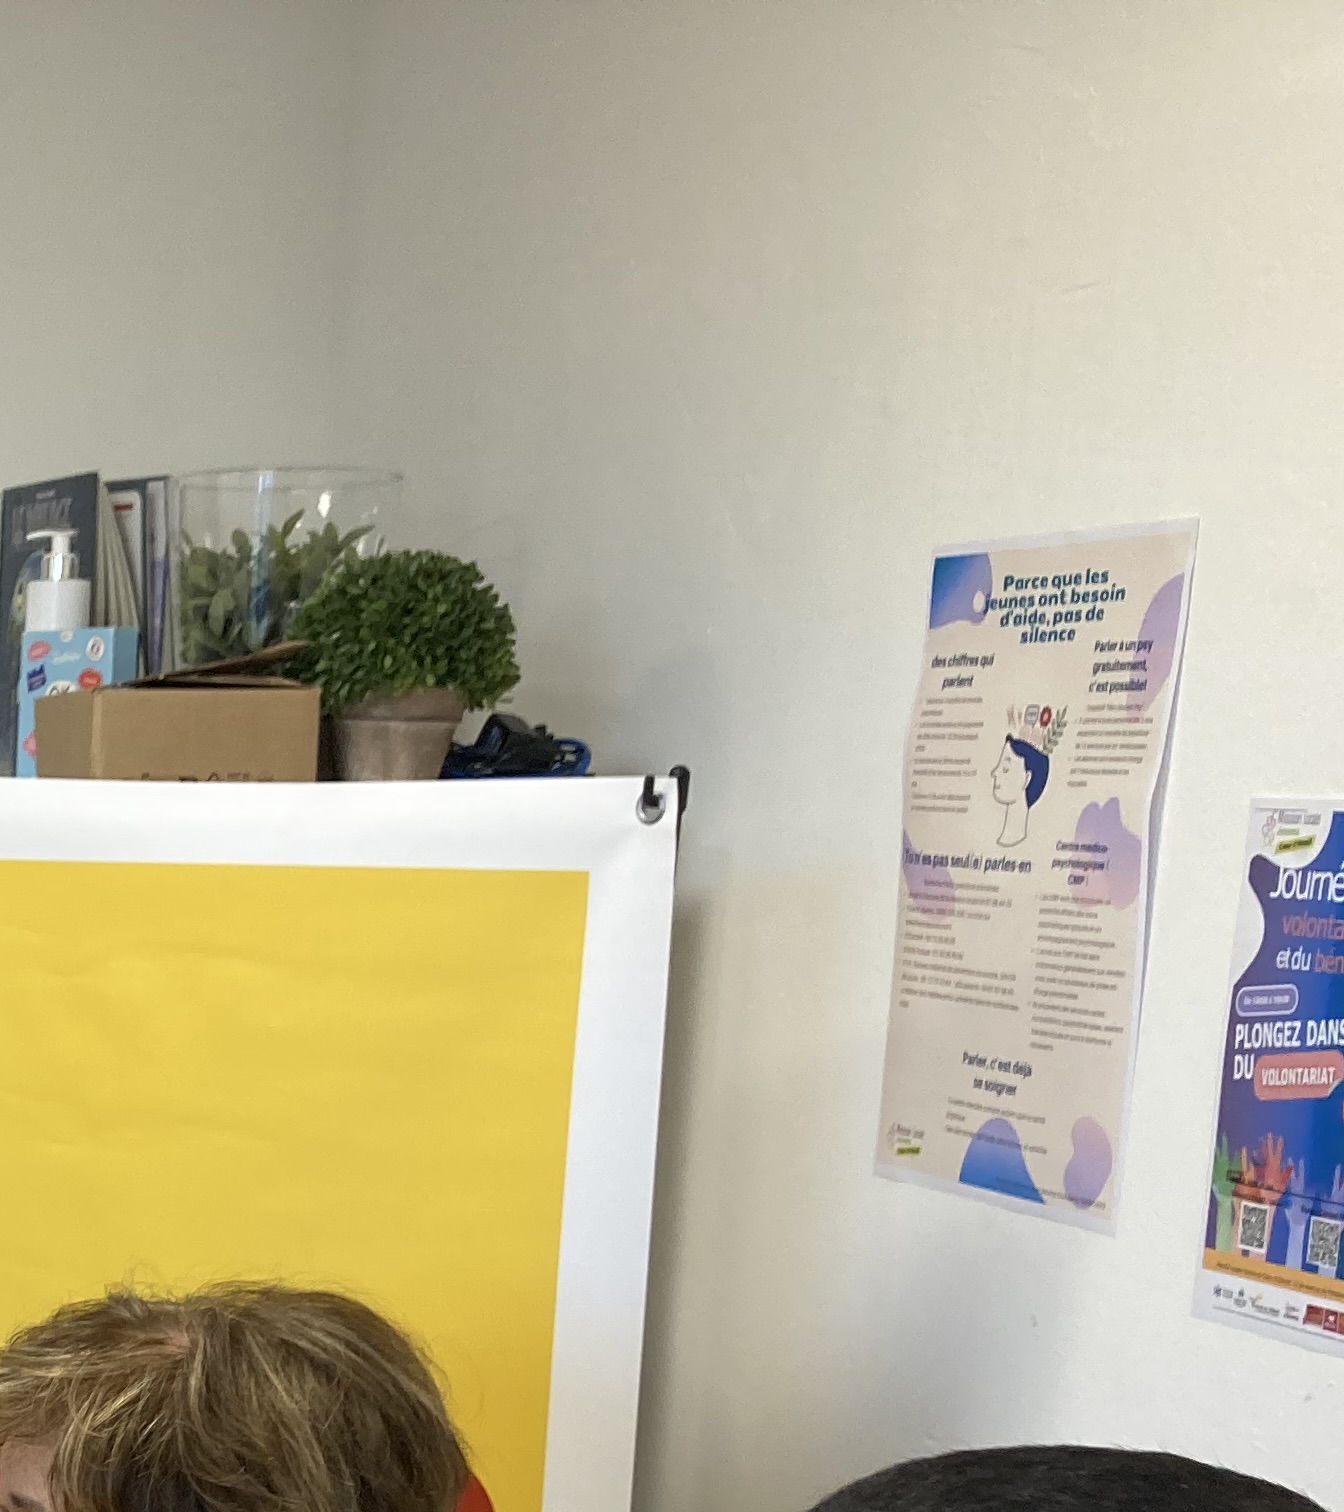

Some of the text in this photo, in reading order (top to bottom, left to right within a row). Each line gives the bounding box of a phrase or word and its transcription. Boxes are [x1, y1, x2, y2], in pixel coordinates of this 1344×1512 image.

[1003, 568, 1110, 592] Parce que les
[983, 583, 1126, 615] jeunes ont besoin
[999, 604, 1105, 629] d'aide, pas de
[1019, 624, 1077, 645] silence
[1276, 947, 1291, 969] et
[1290, 945, 1311, 971] du
[1234, 1019, 1301, 1050] PLONGEZ
[1233, 1054, 1335, 1087] DU VOLONTARIAT
